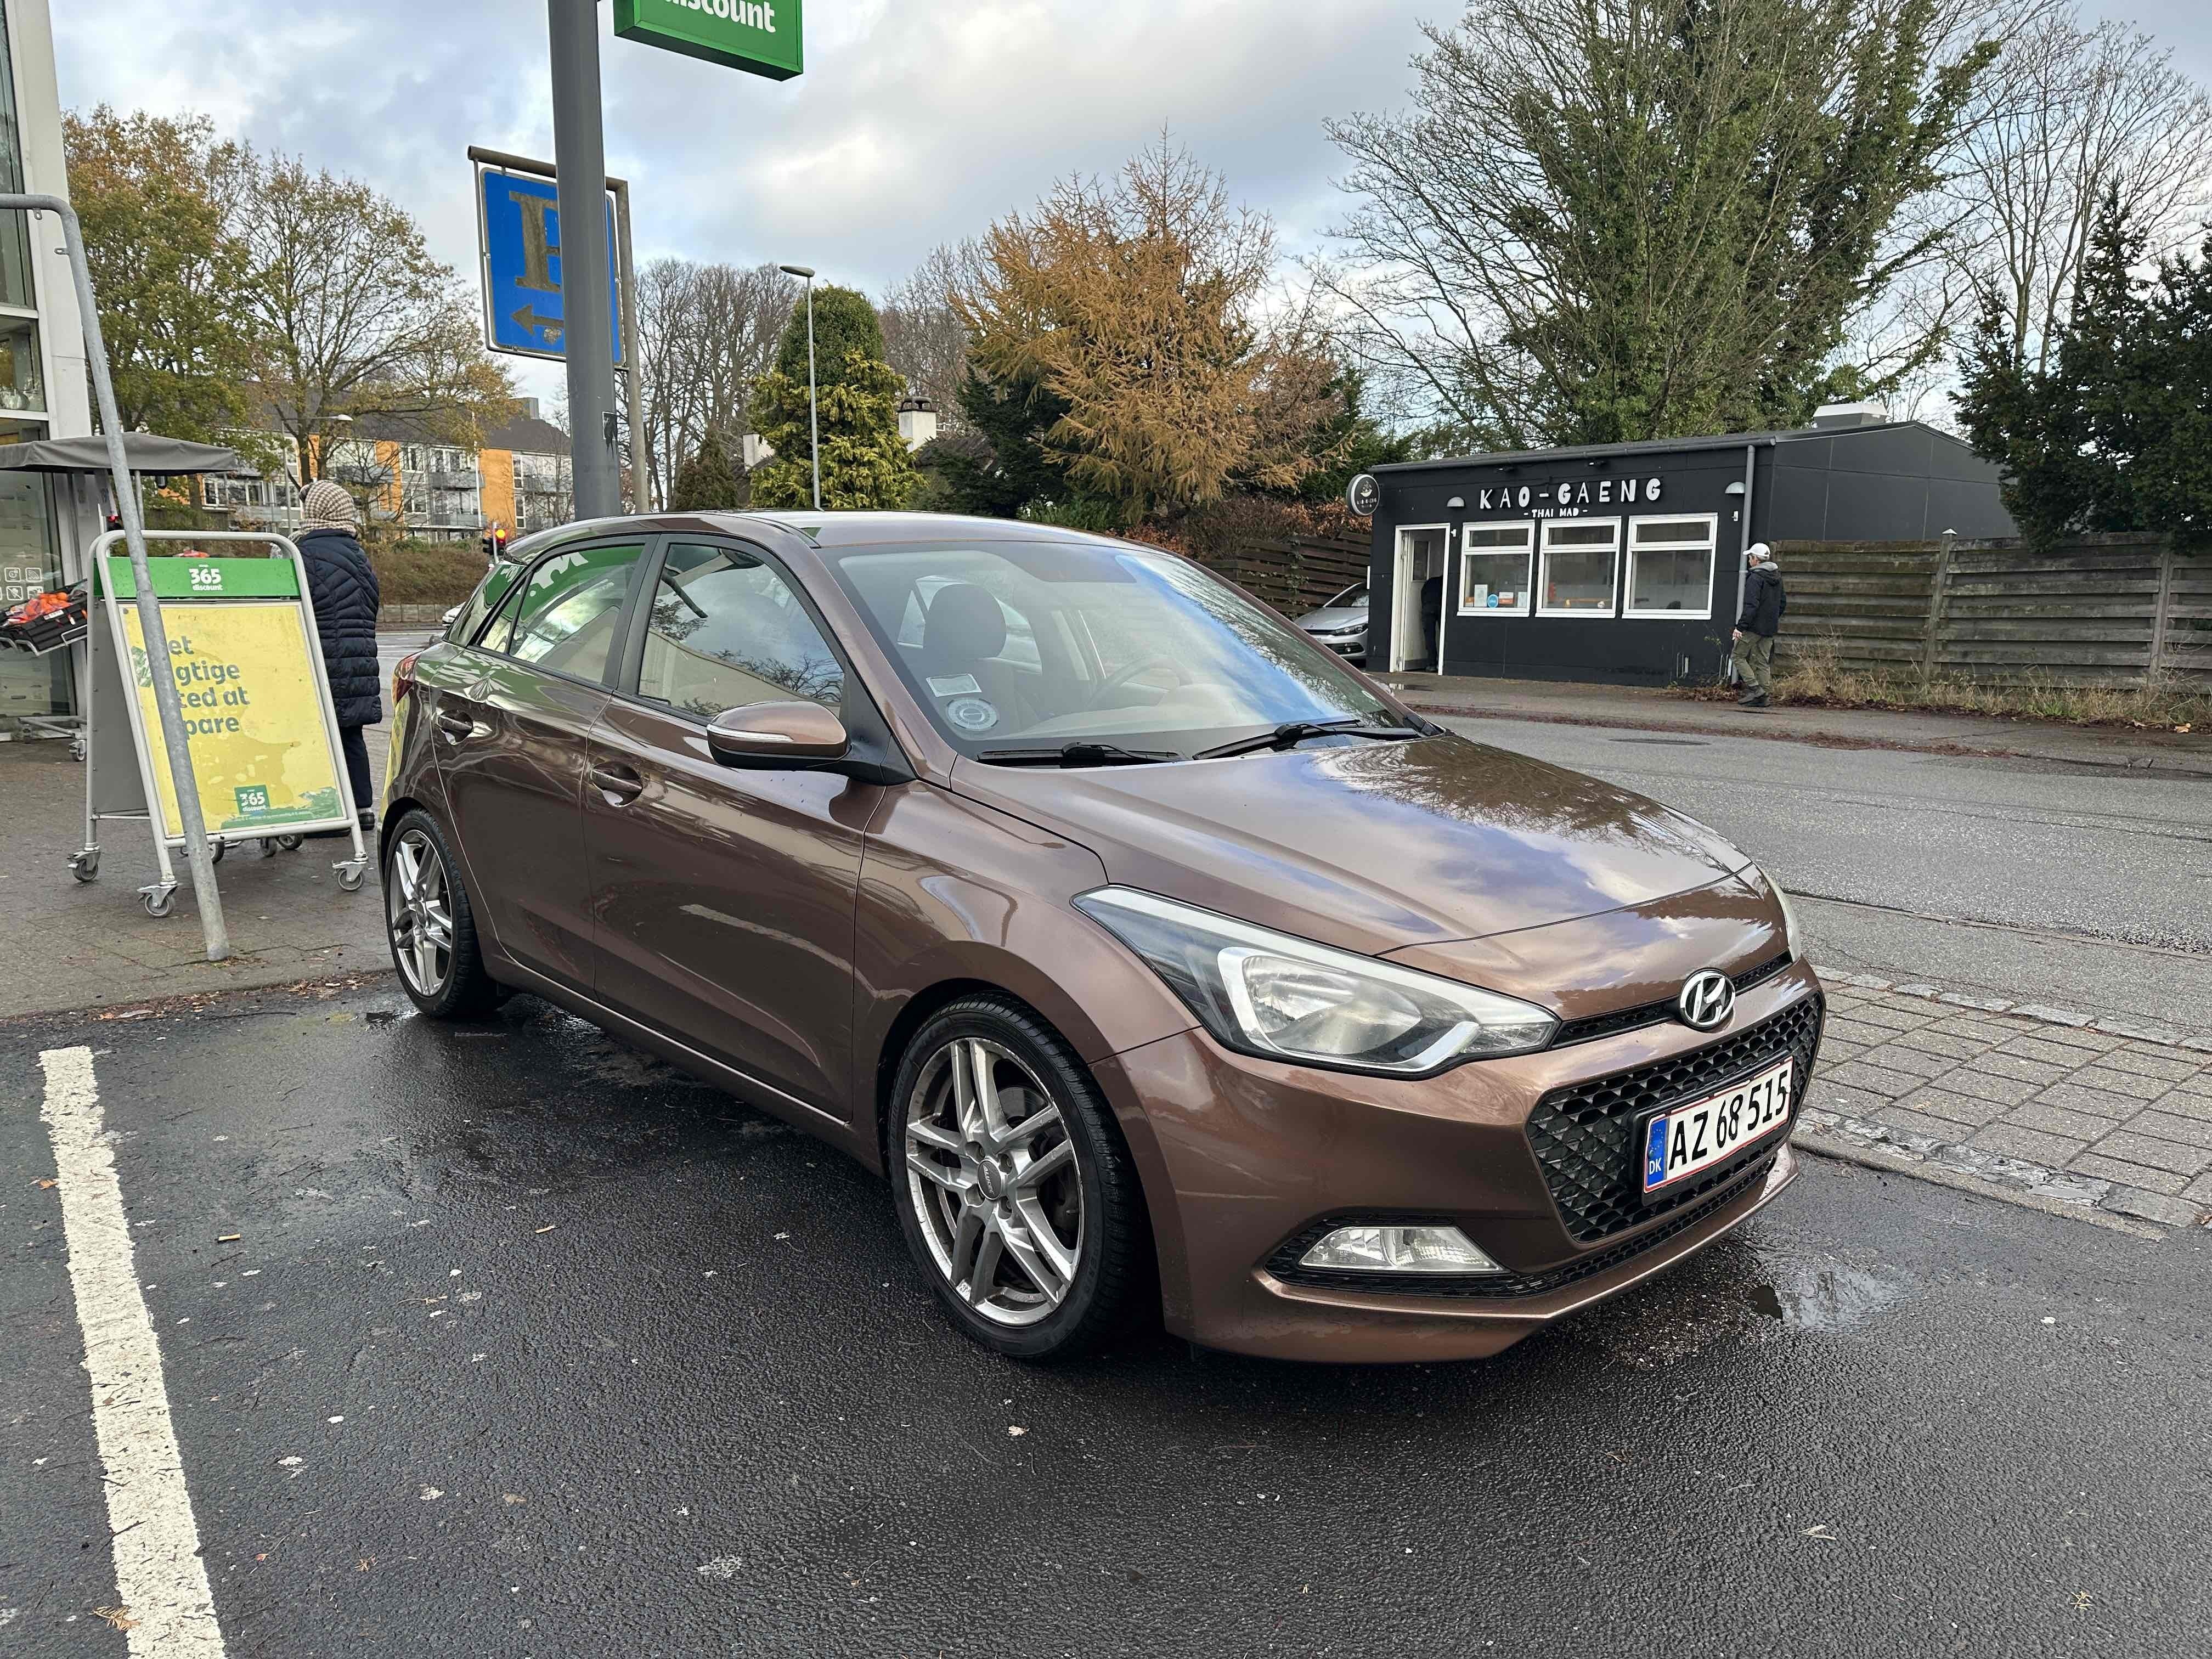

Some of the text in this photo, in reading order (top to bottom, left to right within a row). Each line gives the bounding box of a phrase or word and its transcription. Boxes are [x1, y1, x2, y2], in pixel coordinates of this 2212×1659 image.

[1531, 508, 1554, 518] THAI
[1559, 507, 1579, 517] MAD
[189, 568, 222, 584] 365
[223, 686, 250, 706] at
[239, 792, 266, 806] 365
[1668, 1070, 1788, 1170] AZ 68 515
[1649, 1158, 1661, 1175] DK
